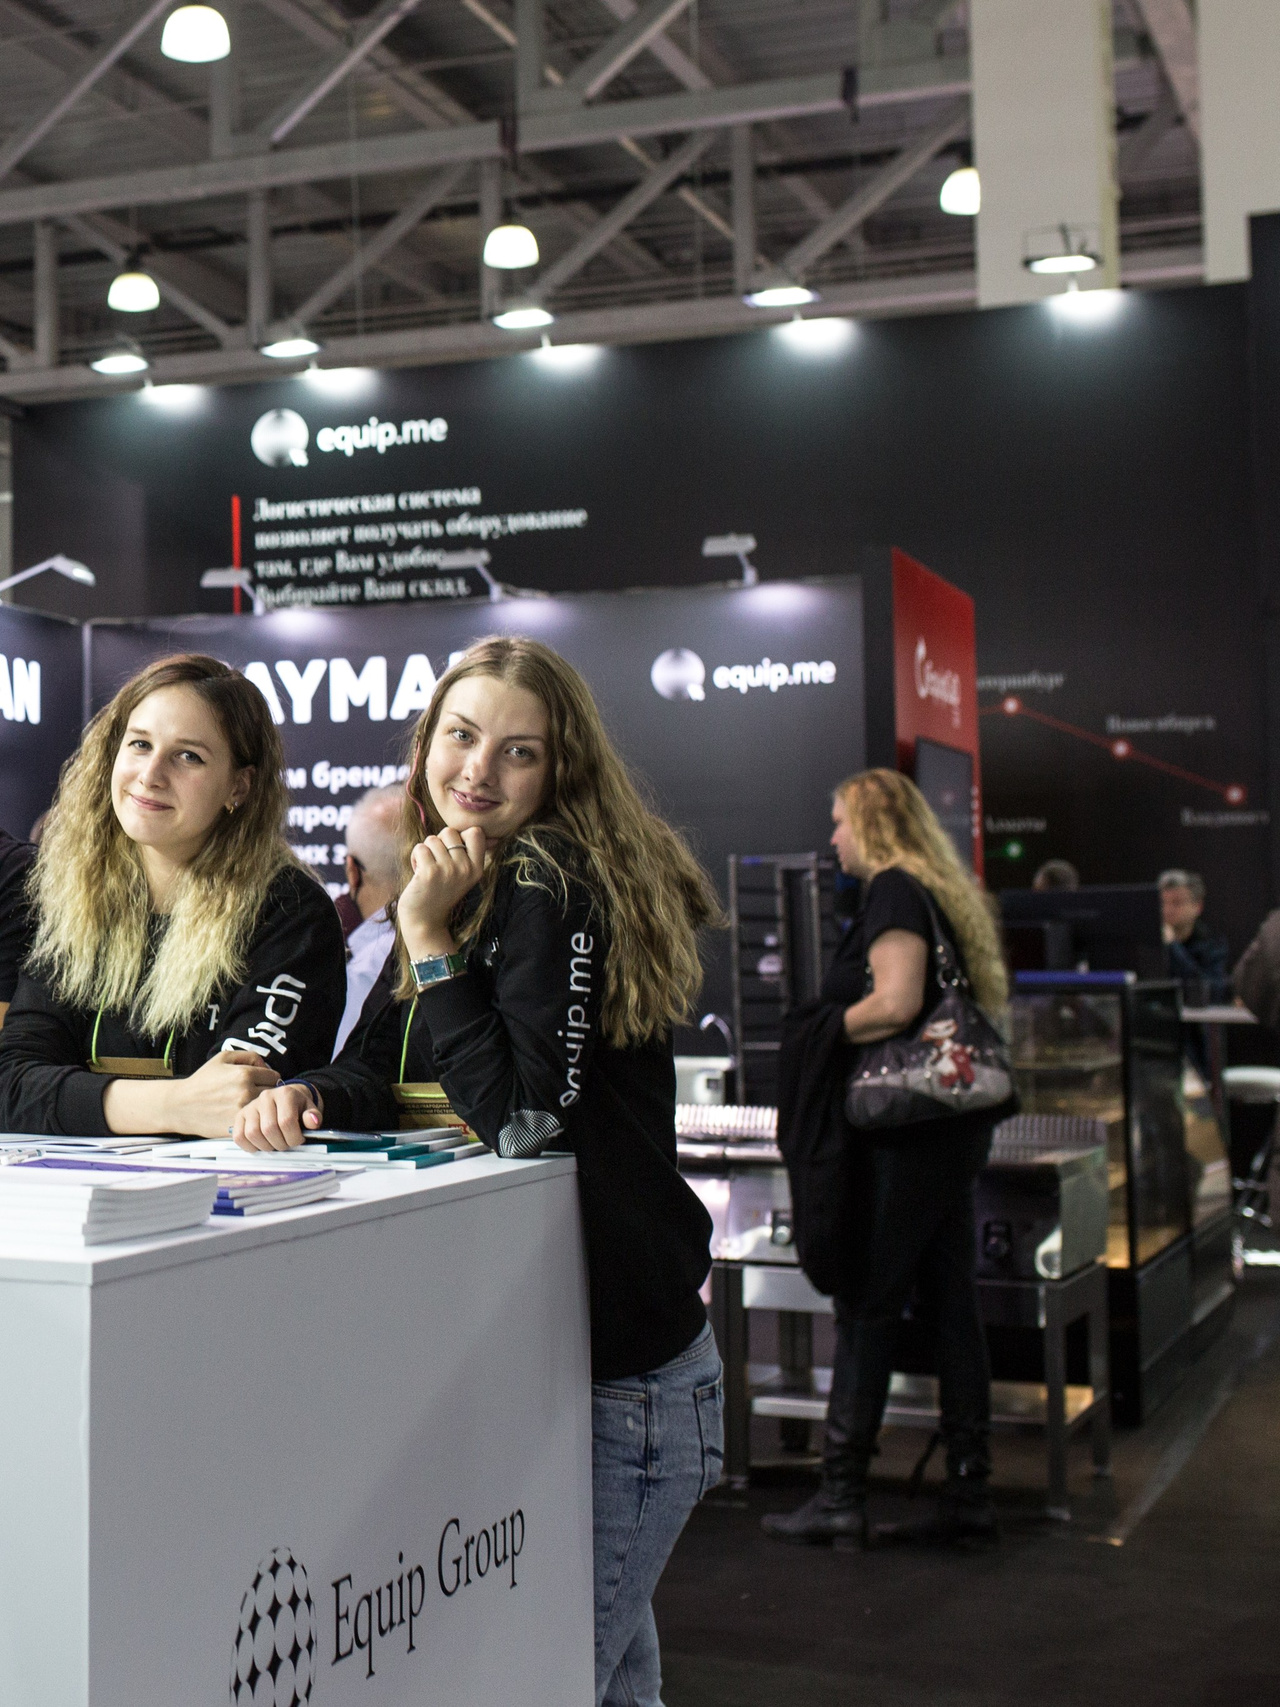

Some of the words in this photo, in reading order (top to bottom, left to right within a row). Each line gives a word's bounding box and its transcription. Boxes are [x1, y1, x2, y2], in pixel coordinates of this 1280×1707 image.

[316, 416, 448, 457] equip.me
[713, 657, 837, 695] equip.me
[331, 1551, 426, 1680] Equip
[437, 1508, 525, 1598] Group
